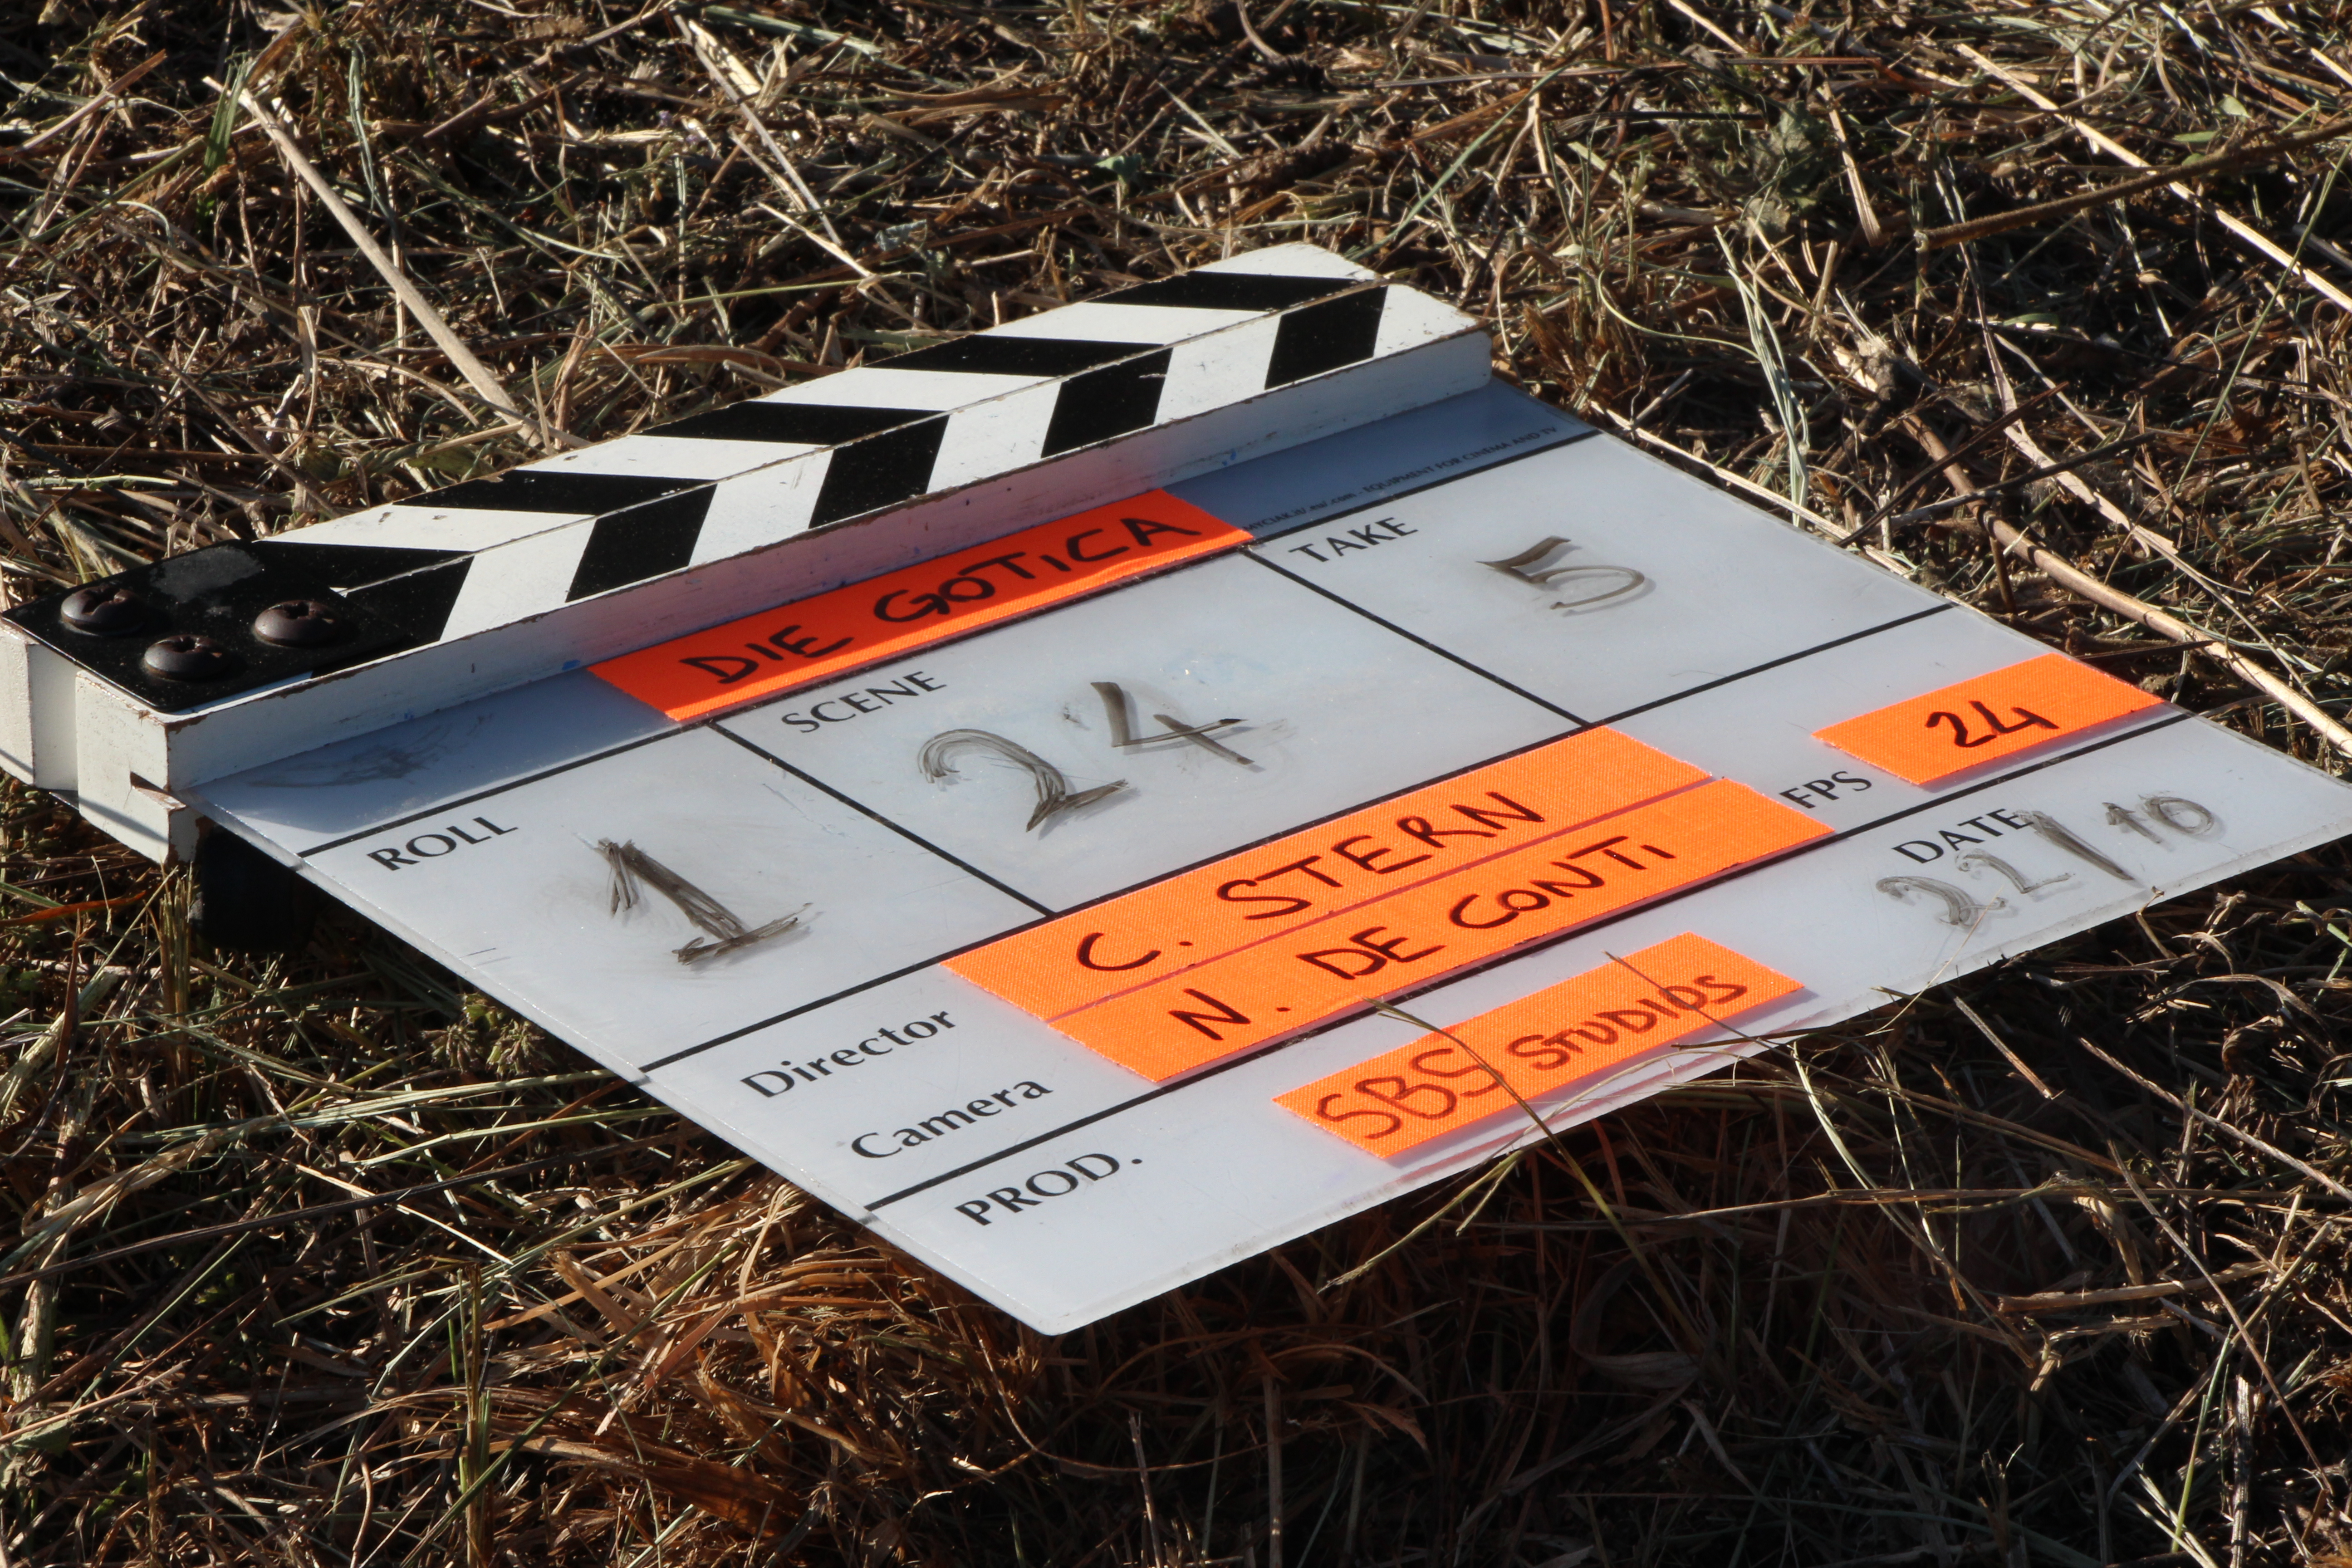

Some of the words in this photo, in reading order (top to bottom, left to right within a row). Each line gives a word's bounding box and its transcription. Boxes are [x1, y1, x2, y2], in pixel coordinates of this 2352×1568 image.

[1362, 465, 1436, 493] EQUIPMENT
[1435, 457, 1462, 470] FOR
[1462, 442, 1512, 461] CINEMA
[1512, 431, 1541, 445] AND
[1539, 426, 1558, 435] TV
[1289, 516, 1418, 563] TAKE
[1475, 535, 1645, 610] 5
[679, 624, 854, 685] DIE
[873, 516, 1202, 622] GOTICA
[780, 671, 947, 734] SCENE
[1925, 700, 2060, 748] 24
[916, 681, 1257, 833] 24
[1779, 770, 1872, 809] FPS
[367, 816, 519, 871] ROLL
[1893, 808, 2032, 864] DATE
[593, 837, 813, 964] 1
[1077, 932, 1193, 971] C.
[1216, 791, 1545, 920] STERN
[1168, 988, 1290, 1041] N.
[1295, 926, 1446, 980] DE
[740, 1010, 957, 1098] Director
[851, 1075, 1053, 1159] Camera
[1316, 1048, 1504, 1139] SBS
[953, 1152, 1143, 1226] PROD.
